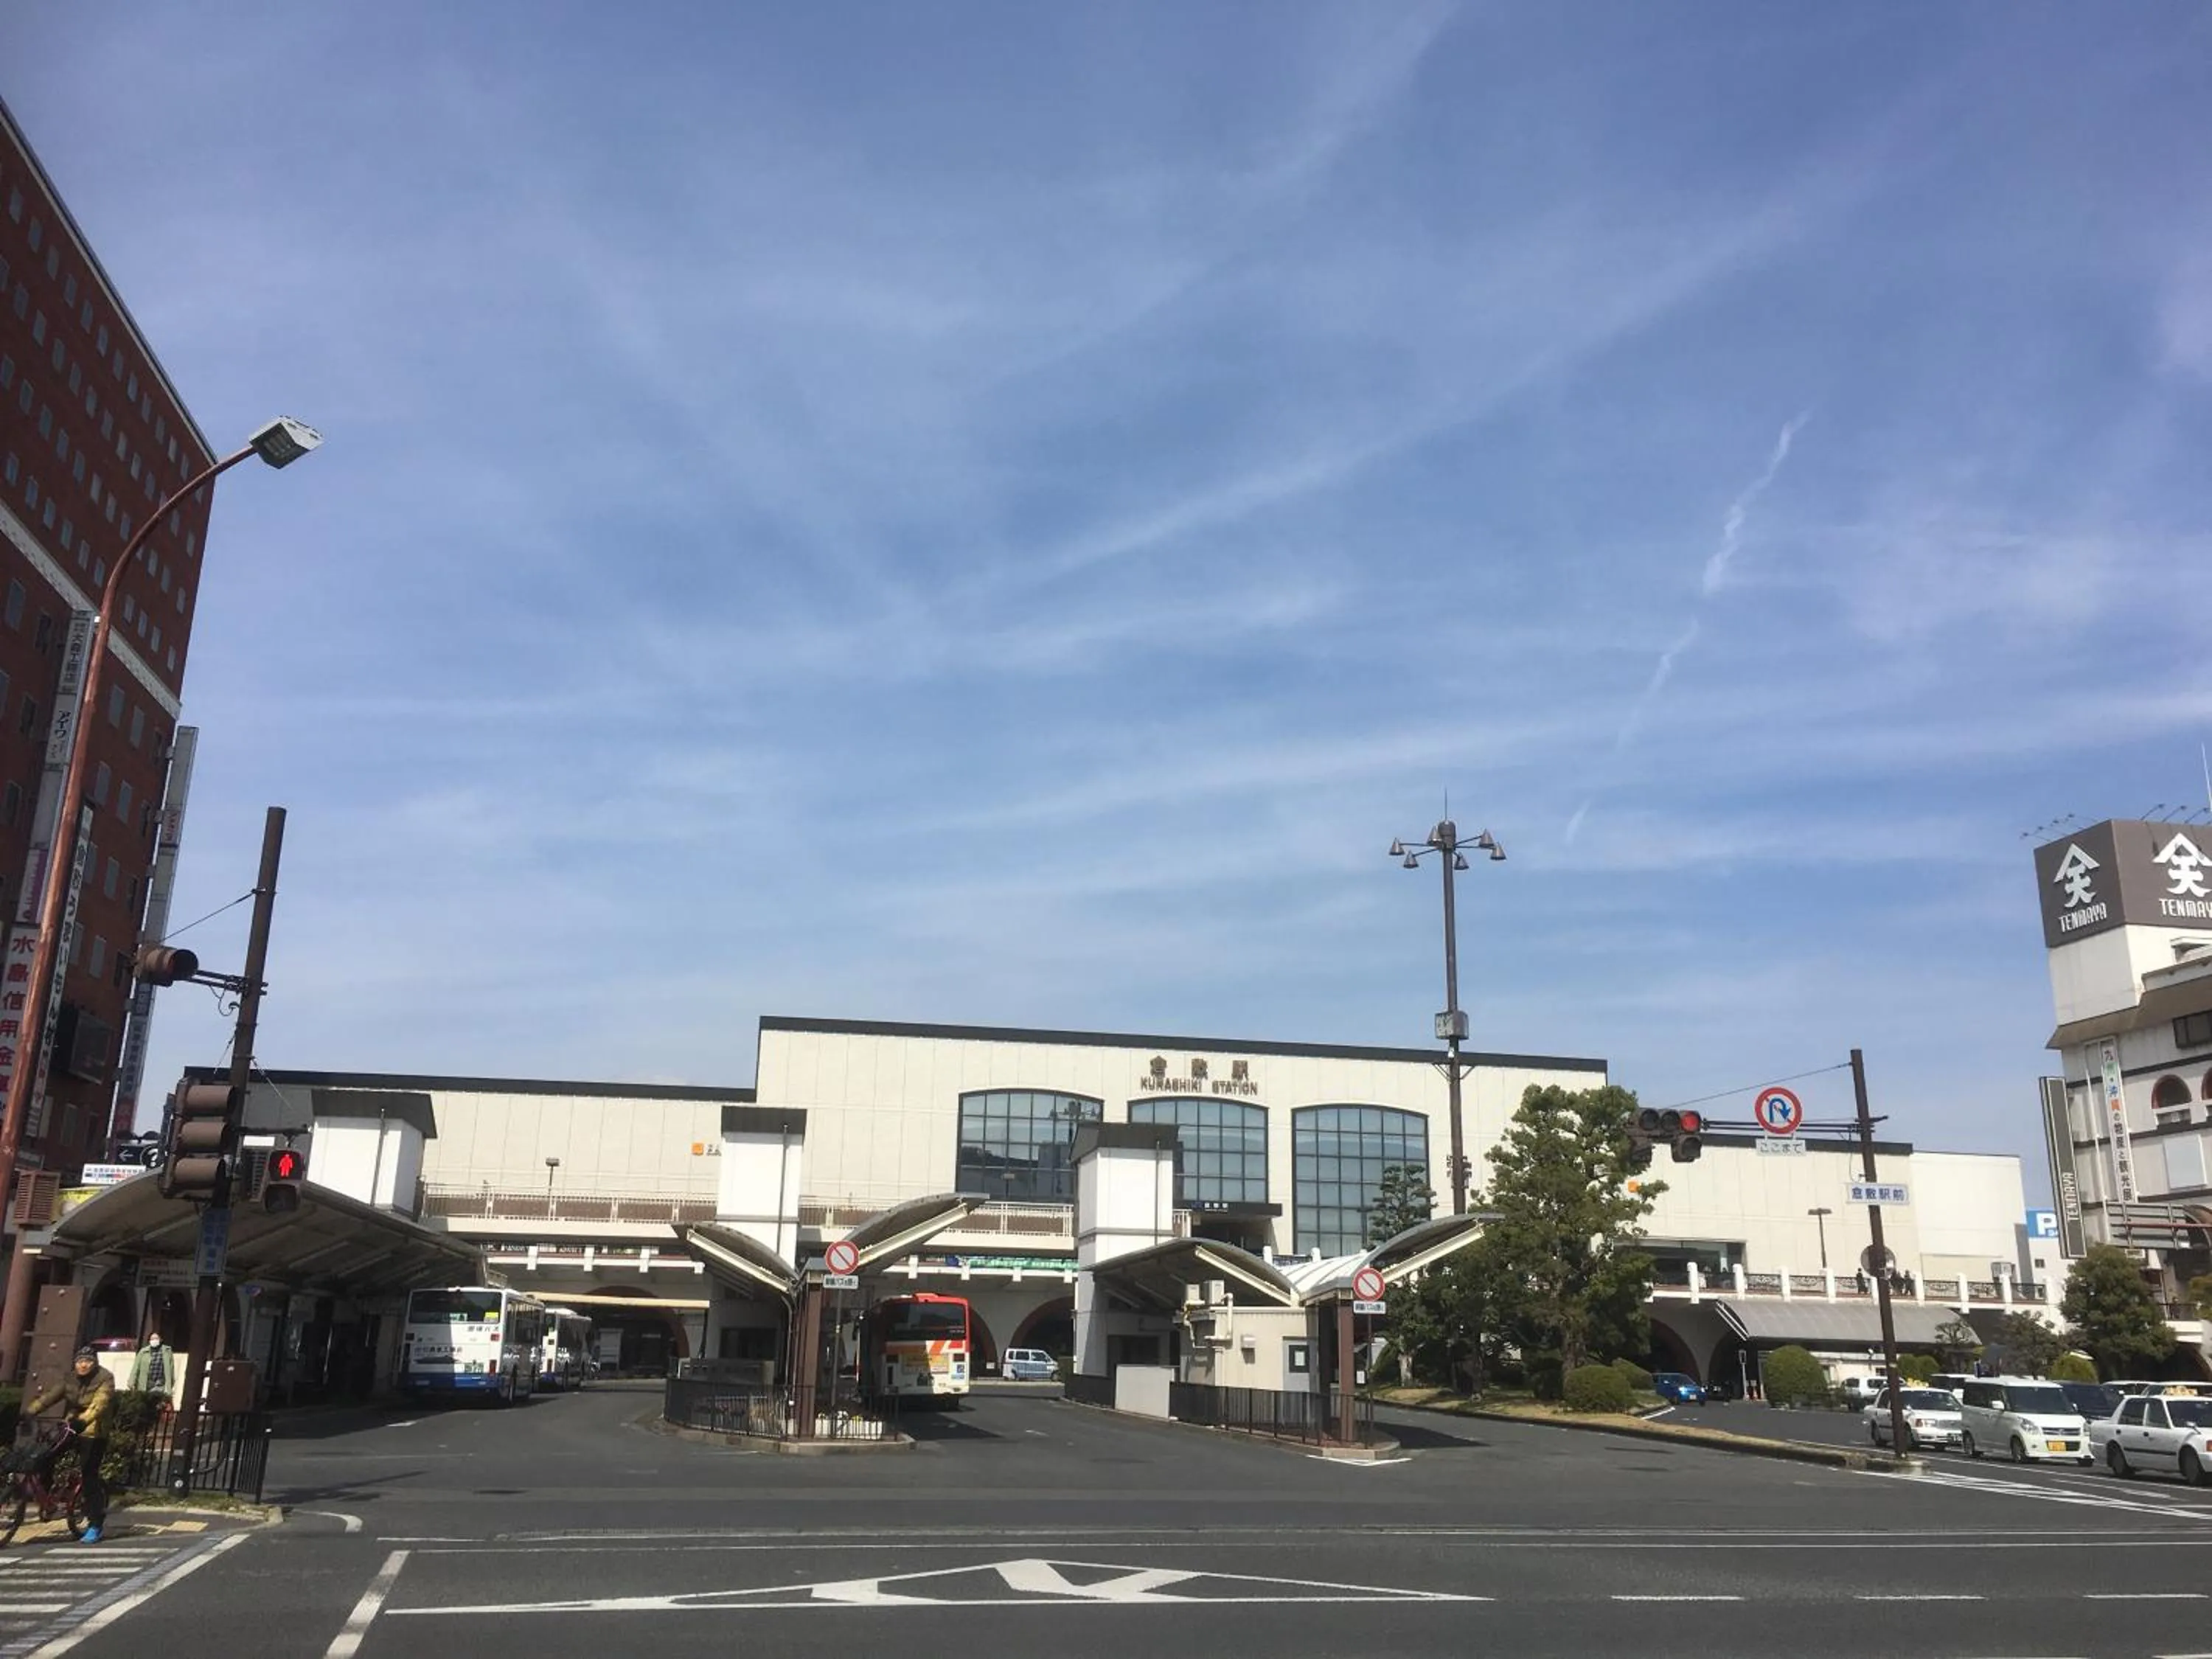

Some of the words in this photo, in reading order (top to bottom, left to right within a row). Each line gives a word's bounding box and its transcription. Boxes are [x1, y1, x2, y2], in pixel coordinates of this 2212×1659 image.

[2059, 902, 2107, 933] TENMAYA
[1150, 1055, 1249, 1080] 倉敷駅
[1141, 1076, 1203, 1093] KURASHIKI
[1211, 1079, 1258, 1096] STATION
[1851, 1186, 1905, 1201] 倉敷駅前
[2037, 1213, 2057, 1236] P
